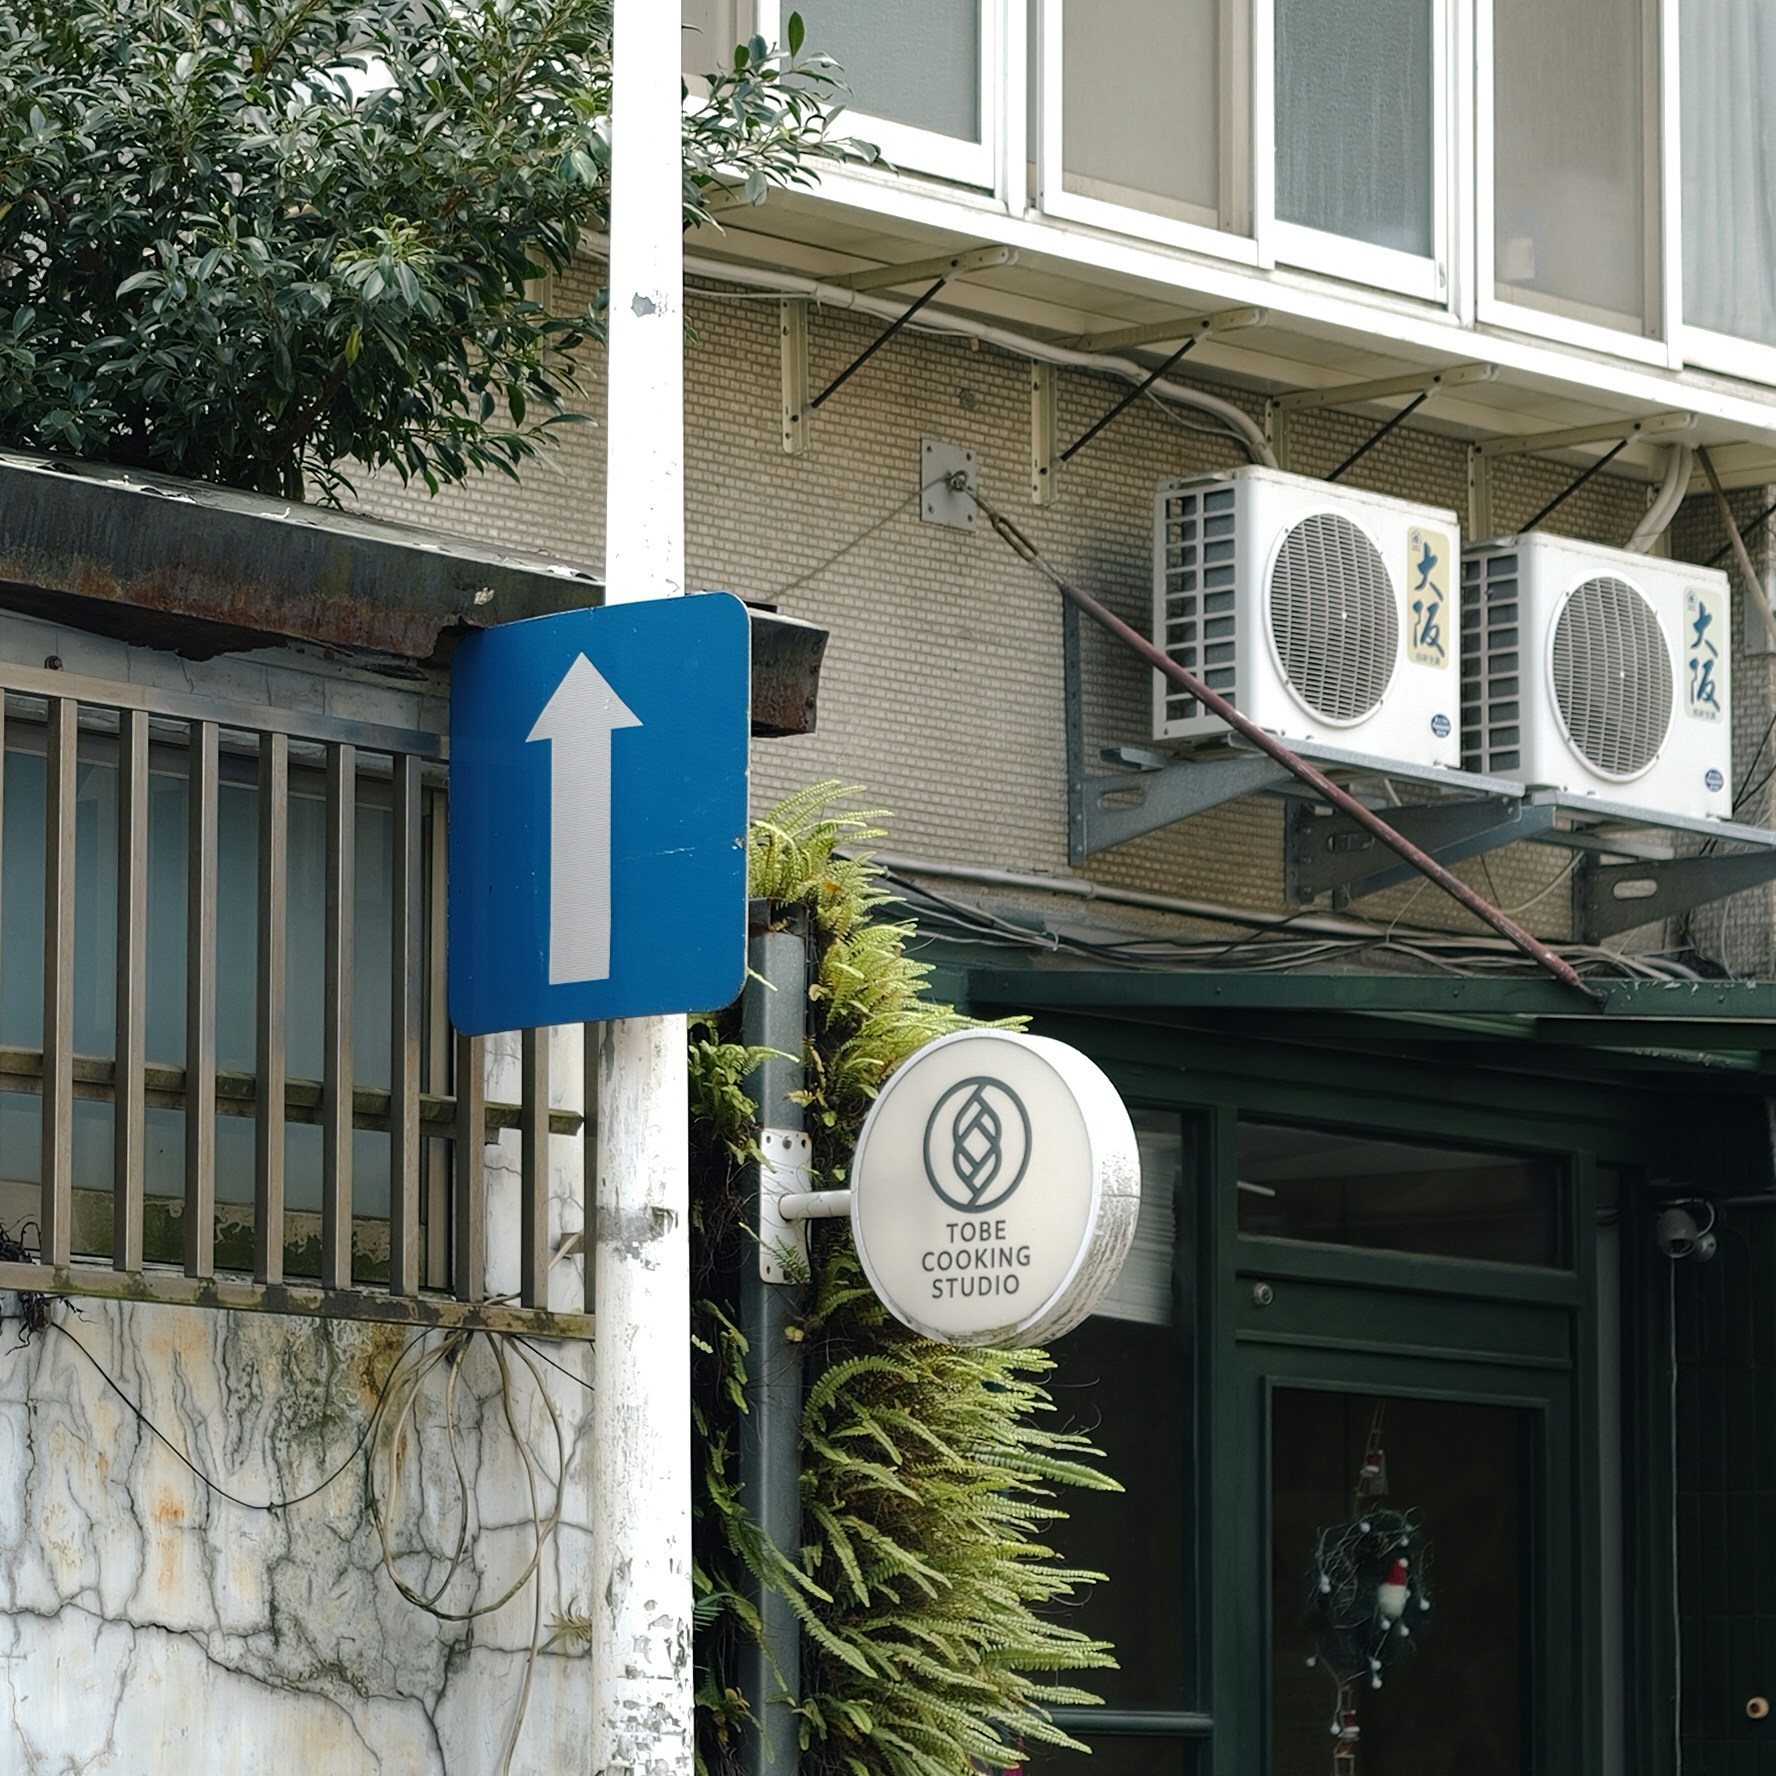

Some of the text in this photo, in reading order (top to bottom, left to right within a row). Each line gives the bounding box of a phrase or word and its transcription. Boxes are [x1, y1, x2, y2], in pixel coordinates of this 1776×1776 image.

[1412, 541, 1445, 658] 大阪
[1689, 600, 1721, 713] 大阪
[945, 1220, 1007, 1243] TOBE
[921, 1245, 1031, 1272] COOKING
[931, 1274, 1020, 1299] STUDIO
